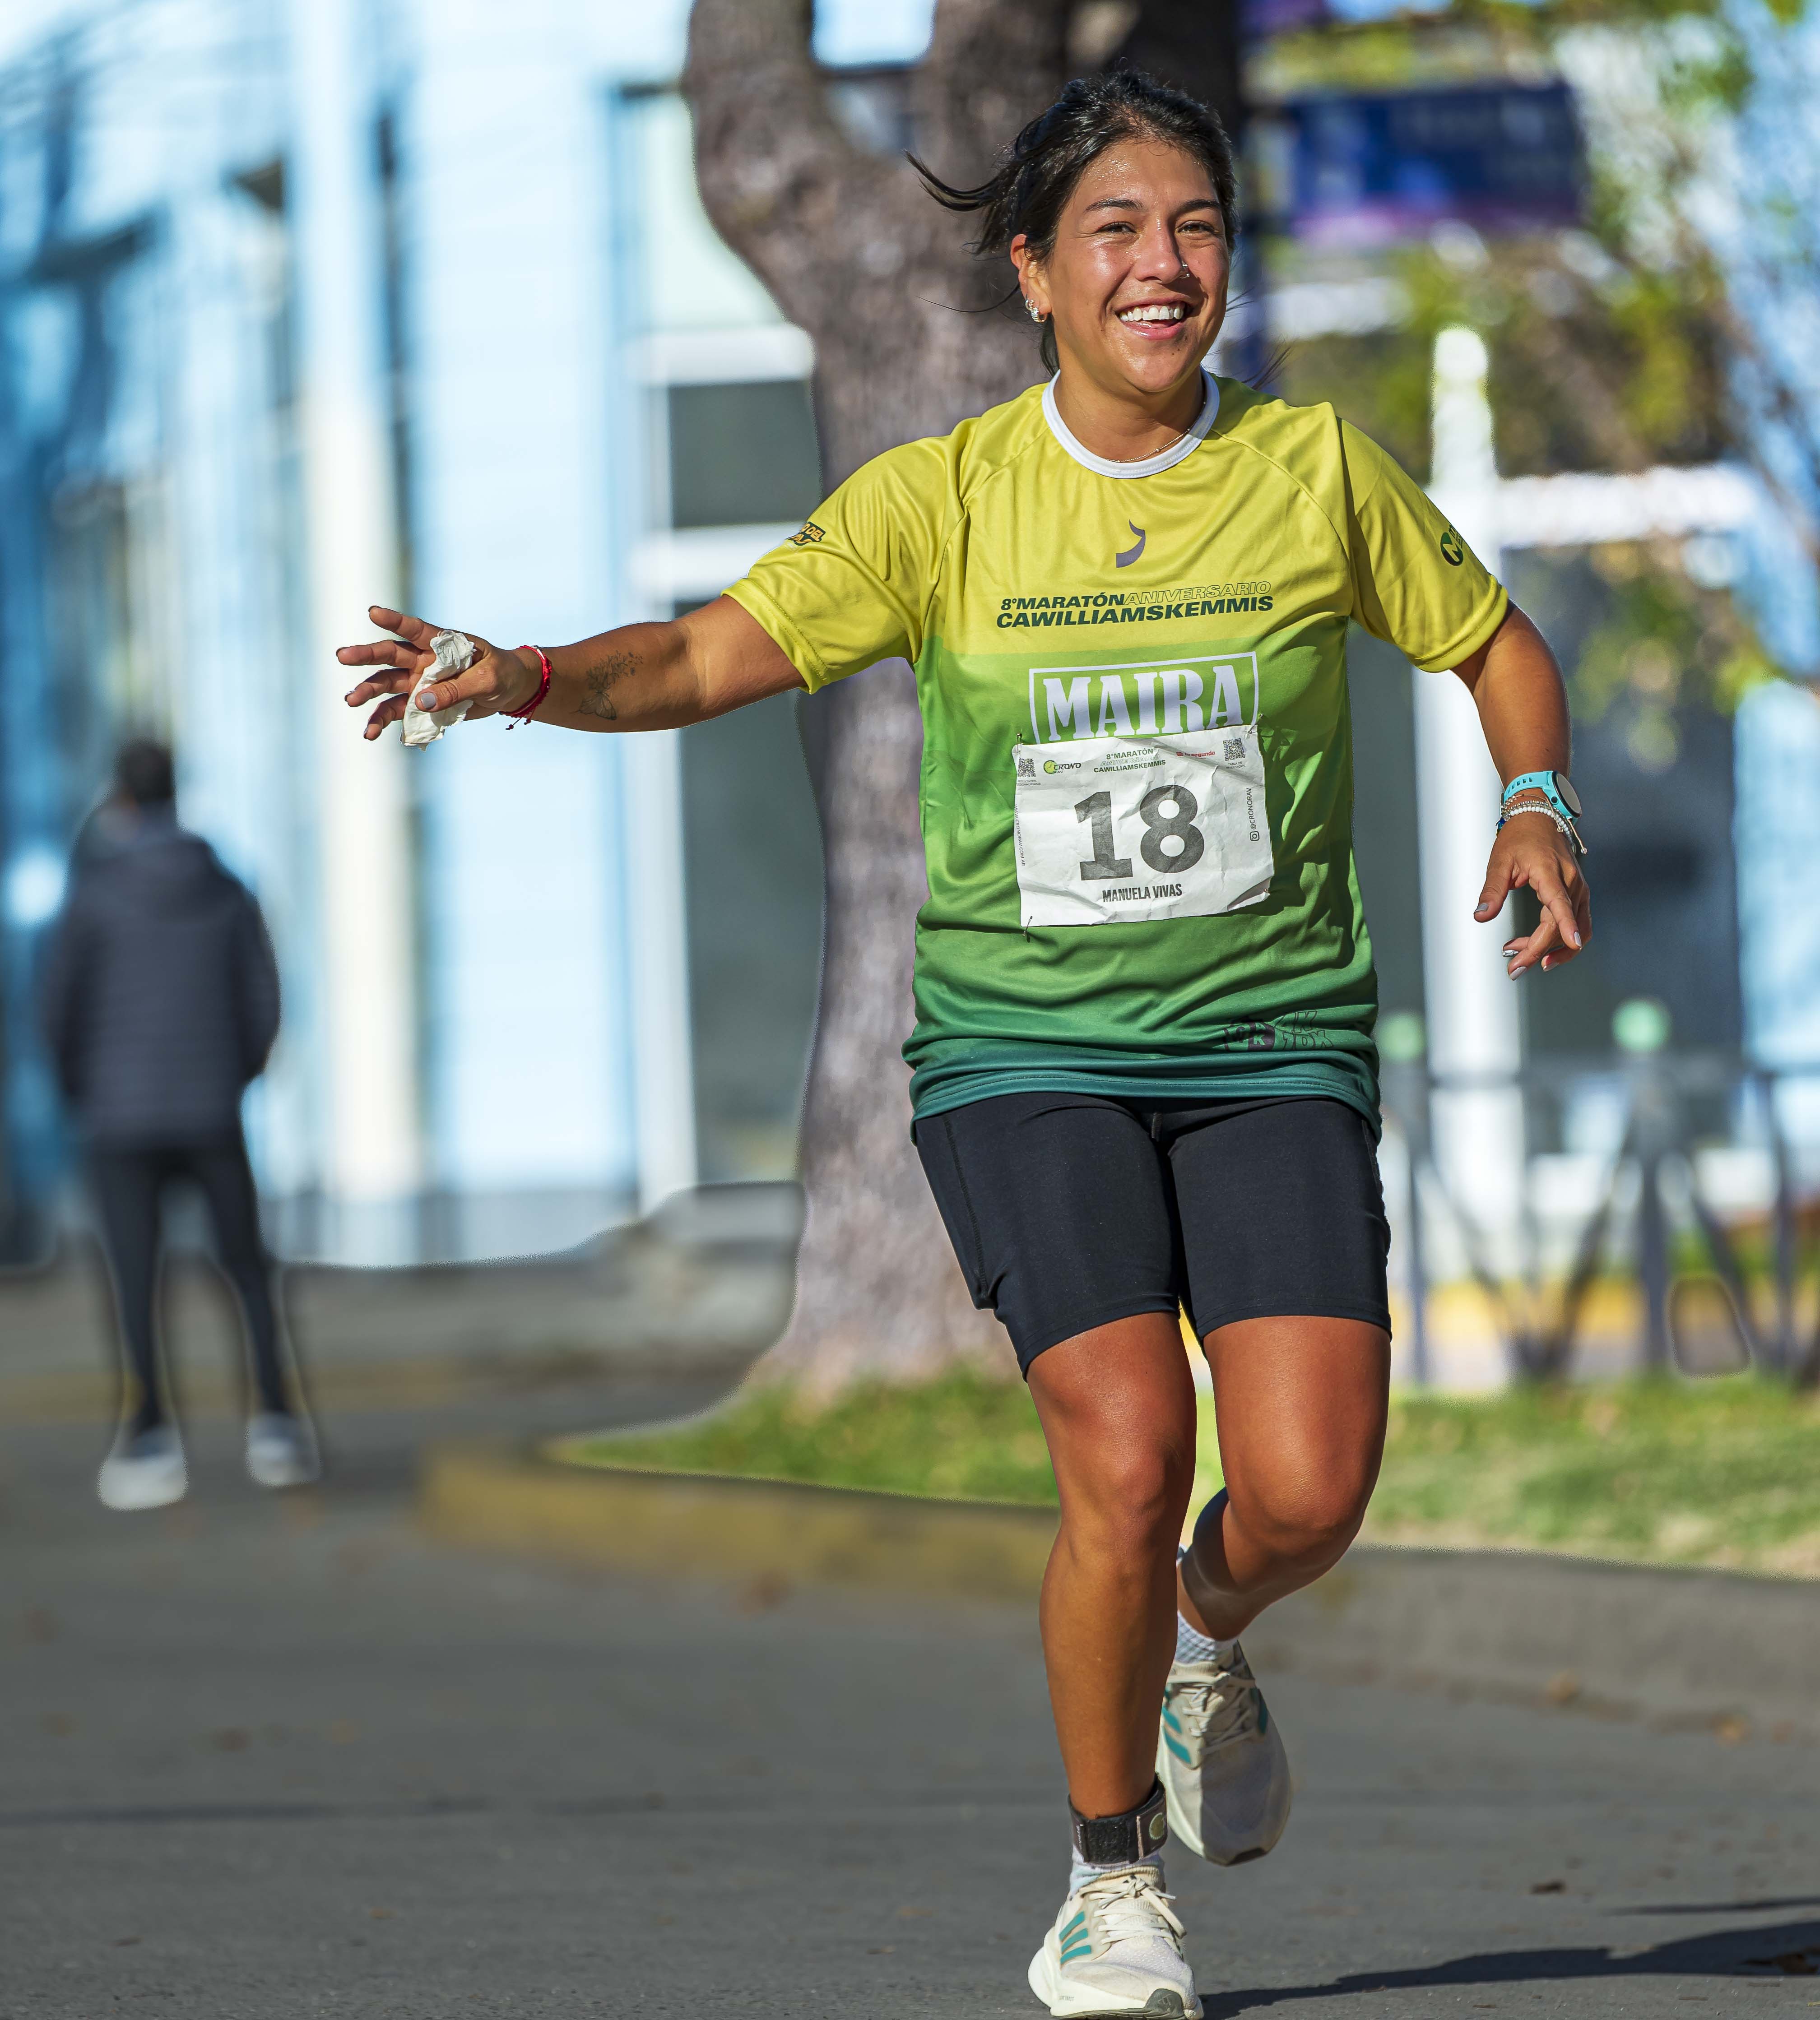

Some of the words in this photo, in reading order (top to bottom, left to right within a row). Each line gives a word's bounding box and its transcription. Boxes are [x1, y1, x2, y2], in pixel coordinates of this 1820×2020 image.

[996, 596, 1273, 628] CAWILLIAMSKEMMIS
[1043, 665, 1244, 741] MAIRA
[1093, 760, 1166, 773] CAWILLIAMSKEMMIS
[1246, 788, 1257, 830] @CRONORAV
[1074, 784, 1205, 880] 18
[1102, 886, 1151, 902] MANUELA
[1152, 883, 1183, 898] VIVAS
